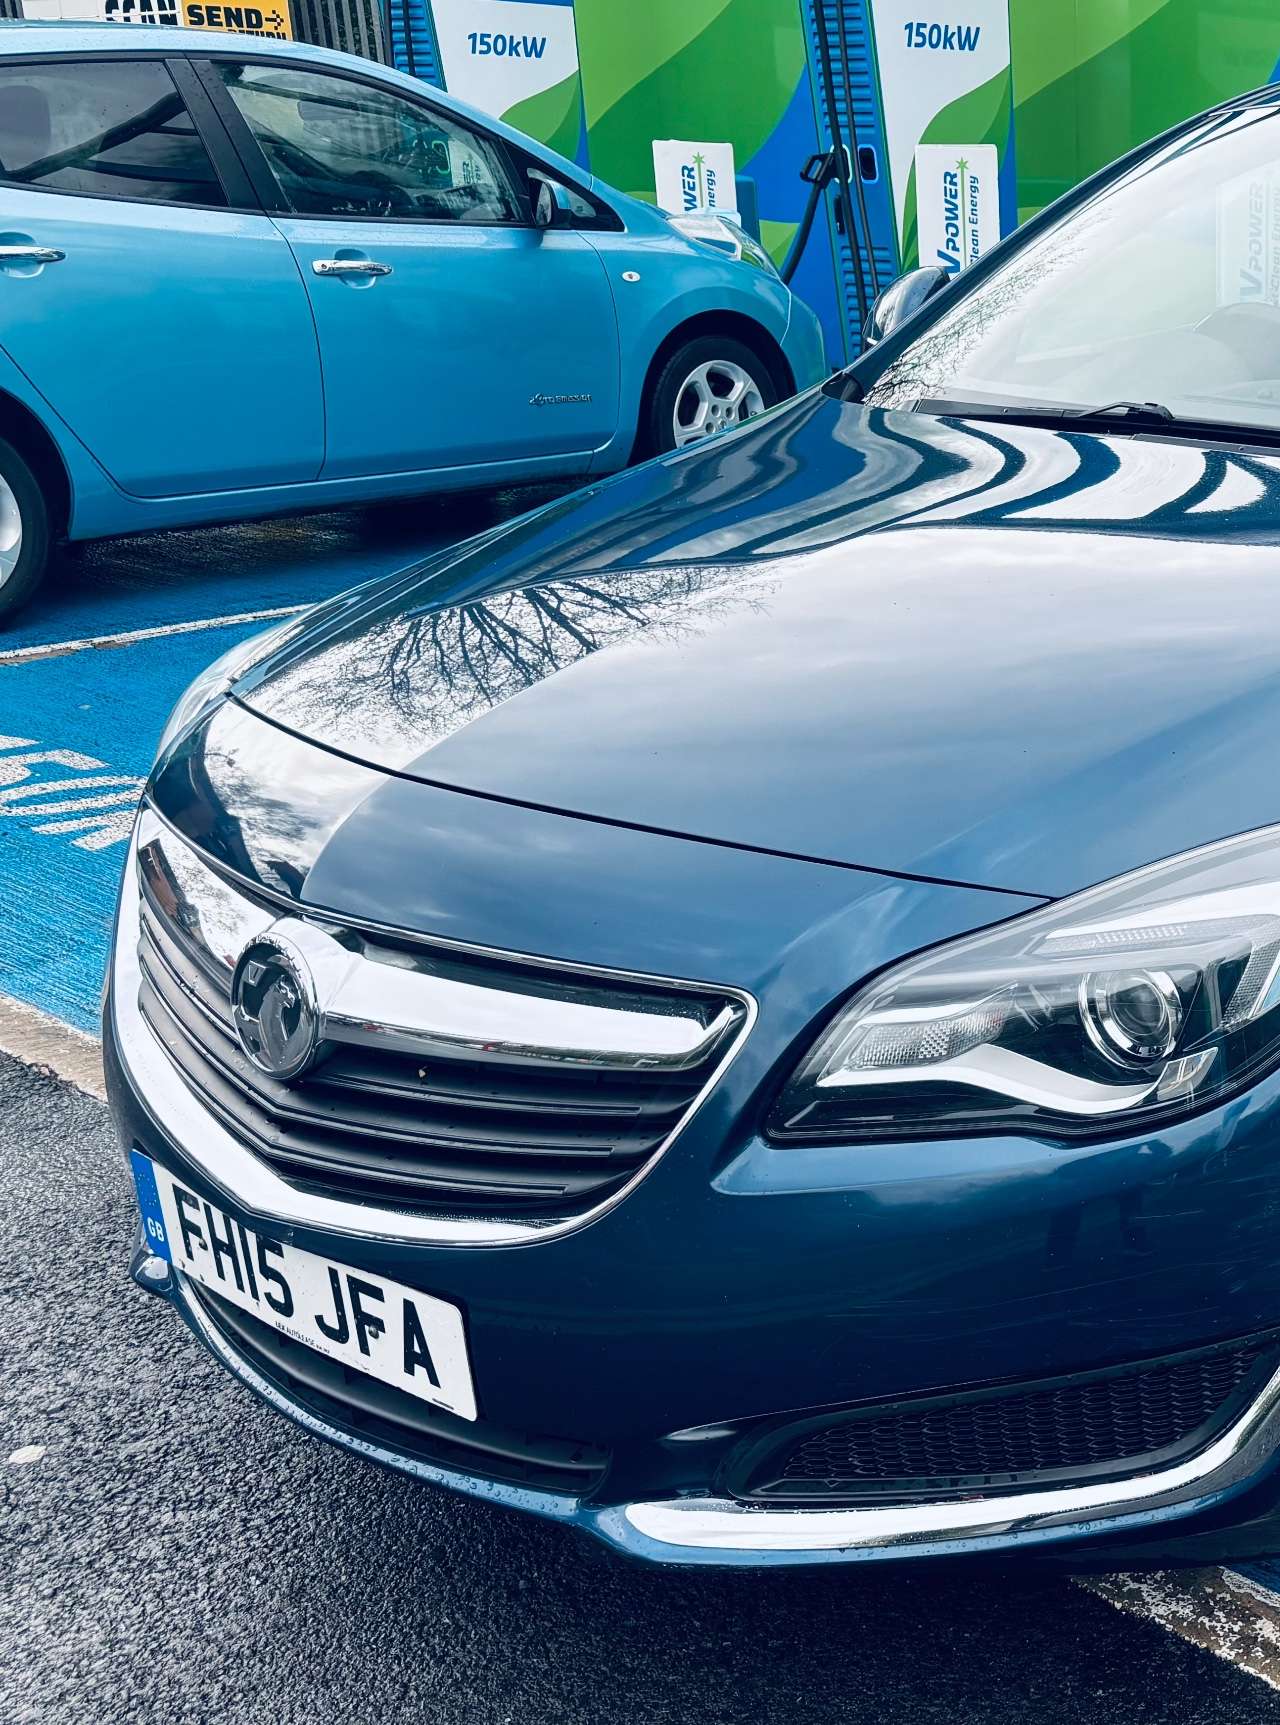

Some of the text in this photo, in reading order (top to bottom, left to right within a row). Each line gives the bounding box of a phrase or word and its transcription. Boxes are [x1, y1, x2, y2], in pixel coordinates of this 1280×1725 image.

[187, 4, 263, 29] SEND
[468, 32, 547, 59] 150kW
[904, 21, 980, 51] 150kW
[969, 175, 980, 225] Energy
[146, 1217, 165, 1243] GB
[172, 1183, 441, 1389] FH15 JFA
